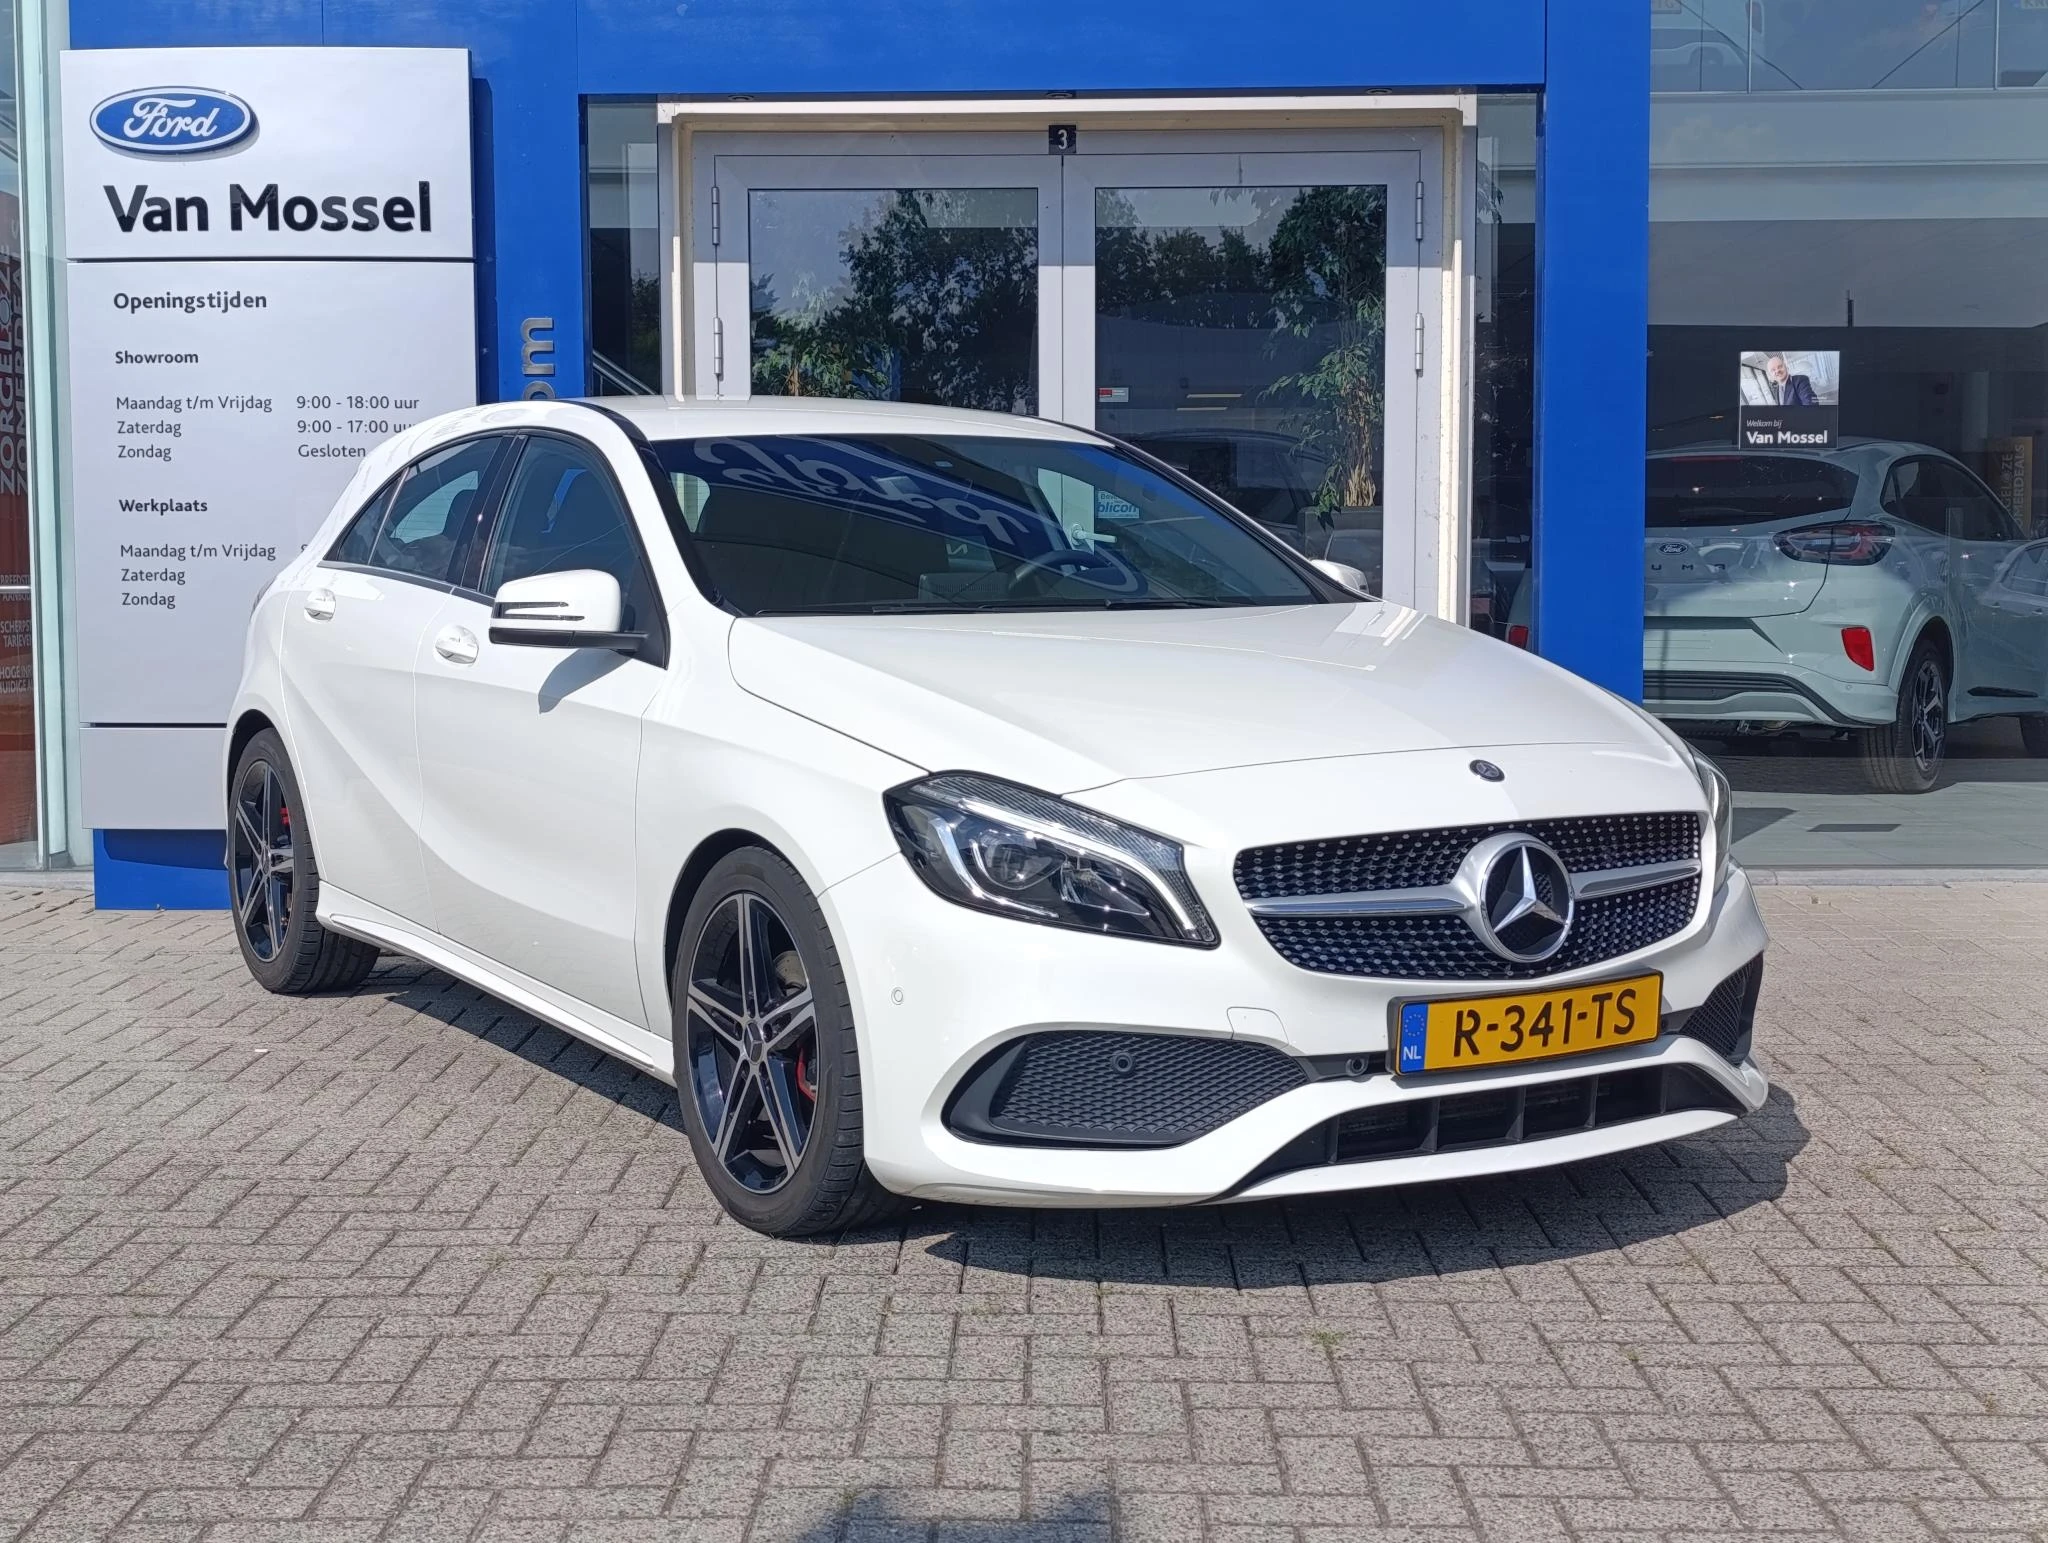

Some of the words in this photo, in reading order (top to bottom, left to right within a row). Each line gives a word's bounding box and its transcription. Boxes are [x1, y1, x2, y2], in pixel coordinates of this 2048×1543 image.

[123, 97, 219, 138] Ford
[1058, 129, 1068, 150] 3
[103, 184, 209, 232] Van
[230, 181, 432, 232] Mossel
[113, 291, 267, 313] Openingstijden
[115, 351, 199, 364] Showroom
[116, 396, 182, 413] Maandag
[186, 396, 214, 410] t/m
[218, 395, 272, 413] Vrijdag
[296, 395, 331, 409] 9:00
[347, 395, 389, 409] 18:00
[394, 398, 419, 409] uur
[117, 420, 182, 437] Zaterdag
[297, 420, 331, 433] 9:00
[347, 420, 388, 433] 17:00
[1746, 419, 1773, 427] Welkom
[1746, 431, 1773, 444] Van
[1778, 430, 1828, 444] Mossel
[118, 444, 172, 461] Zondag
[298, 444, 366, 457] Gesloten
[119, 498, 208, 516] Werkplaats
[120, 544, 186, 561] Maandag
[190, 544, 217, 557] t/m
[222, 544, 276, 561] Vrijdag
[121, 568, 185, 585] Zaterdag
[122, 592, 175, 609] Zondag
[1453, 988, 1637, 1057] R-341-TS
[1403, 1045, 1421, 1061] NL
